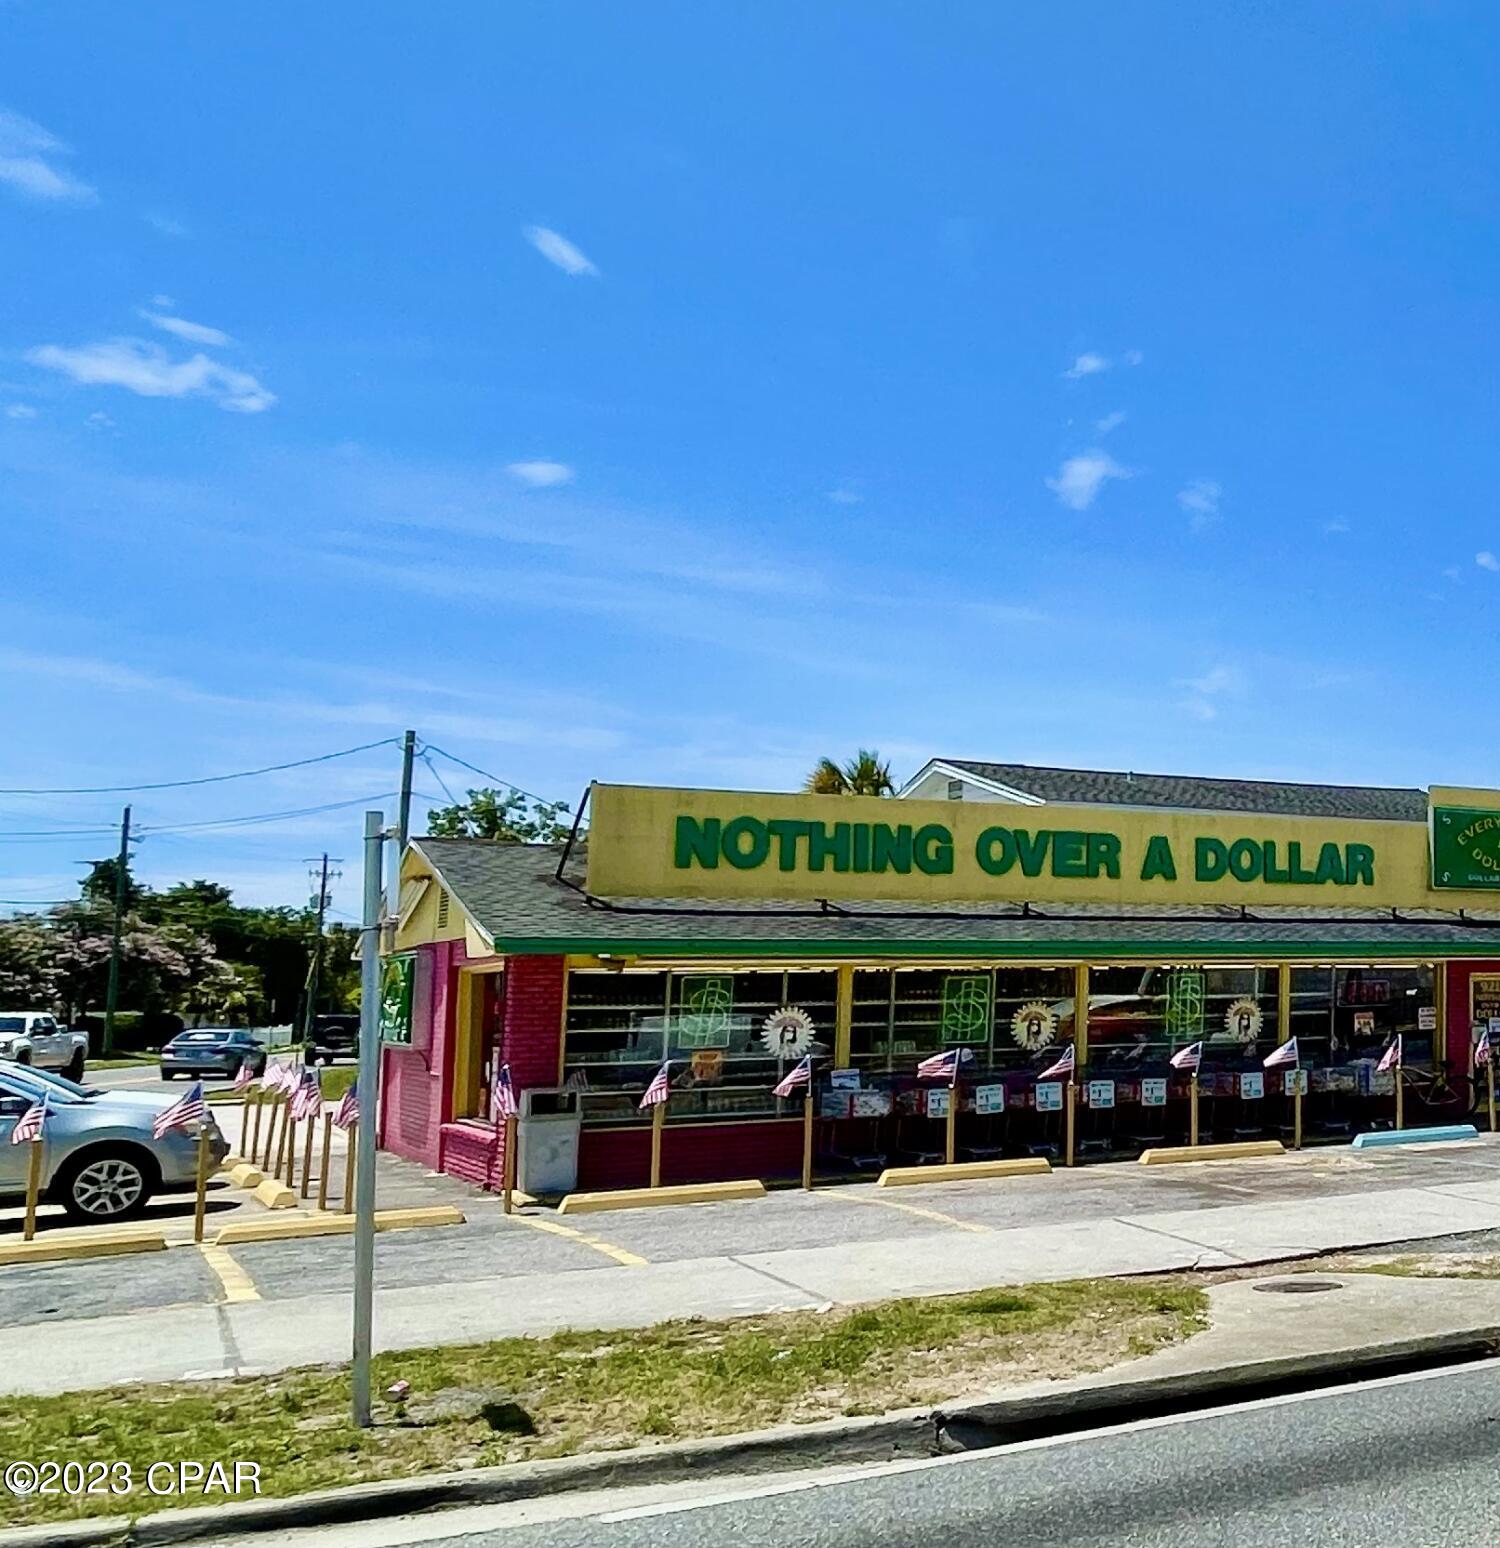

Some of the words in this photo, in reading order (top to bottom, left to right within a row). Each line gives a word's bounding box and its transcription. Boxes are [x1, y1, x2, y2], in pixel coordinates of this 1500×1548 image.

[675, 815, 954, 875] NOTHING
[975, 826, 1122, 879] OVER
[1141, 835, 1176, 880] A
[1195, 836, 1375, 886] DOLLAR
